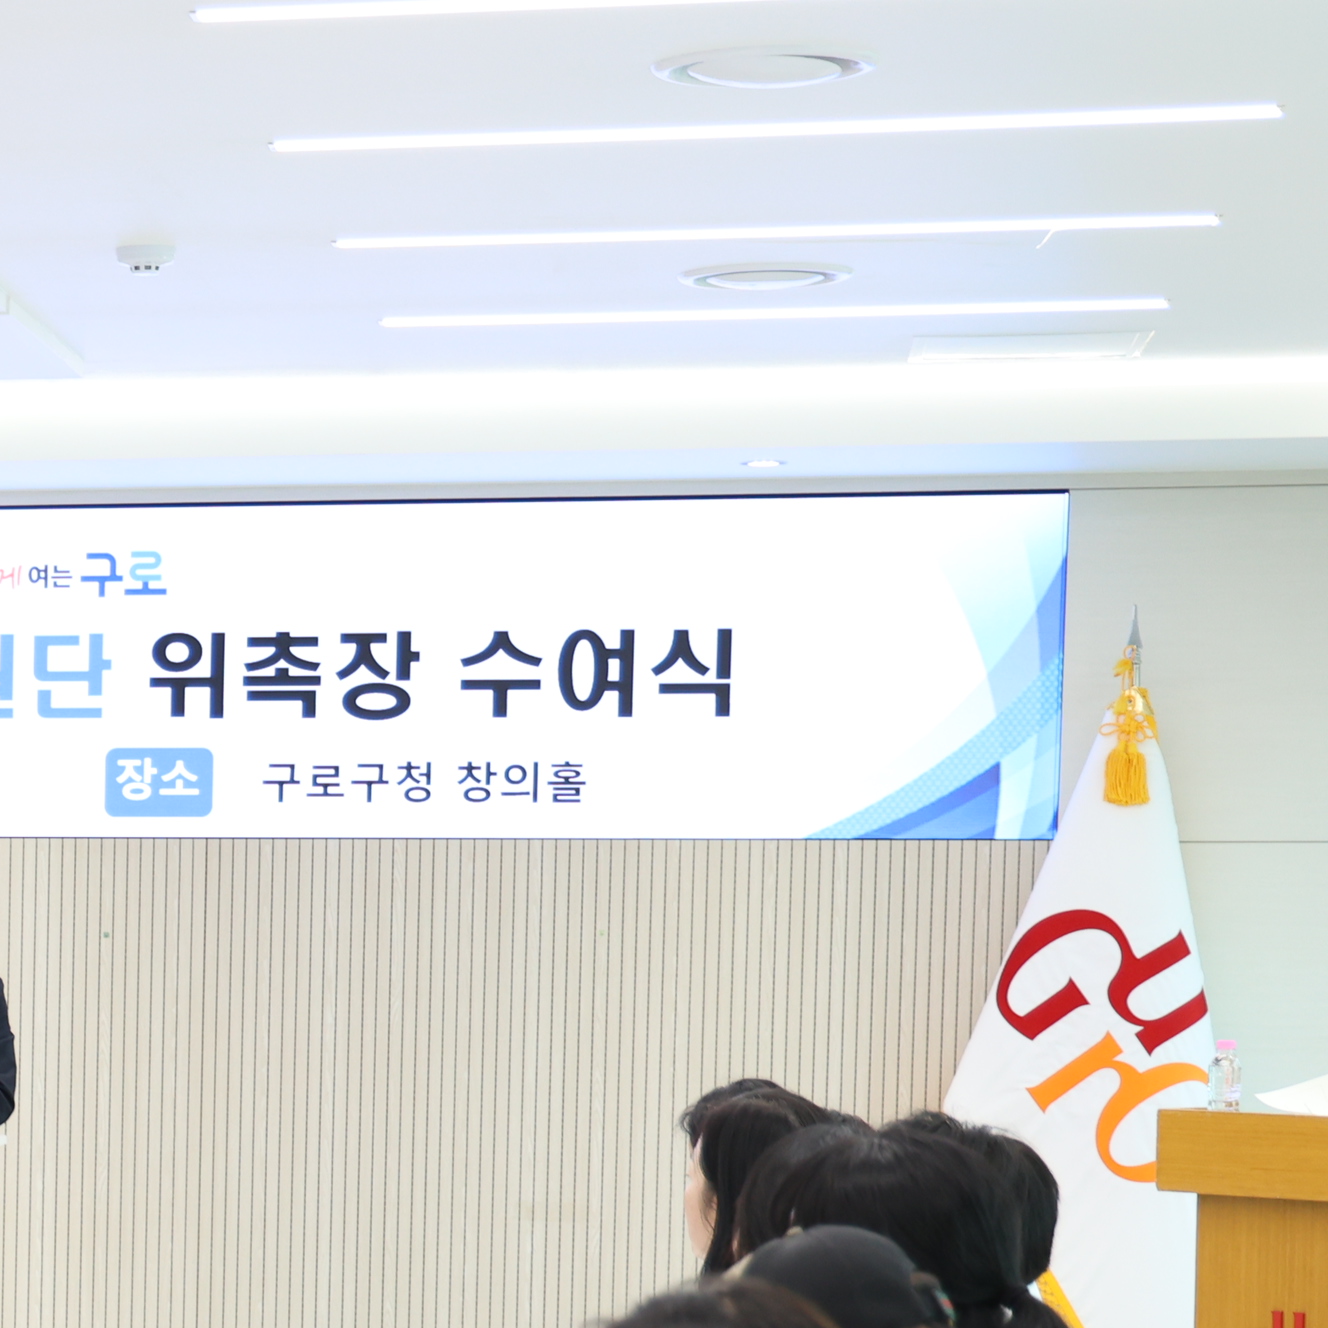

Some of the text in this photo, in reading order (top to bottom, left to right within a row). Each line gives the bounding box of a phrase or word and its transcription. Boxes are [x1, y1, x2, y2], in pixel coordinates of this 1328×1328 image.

[29, 565, 73, 589] 여는
[80, 551, 168, 598] 구로
[149, 631, 421, 722] 위촉장
[460, 628, 733, 719] 수여식
[117, 758, 588, 804] 장소 구로구청 창의홀
